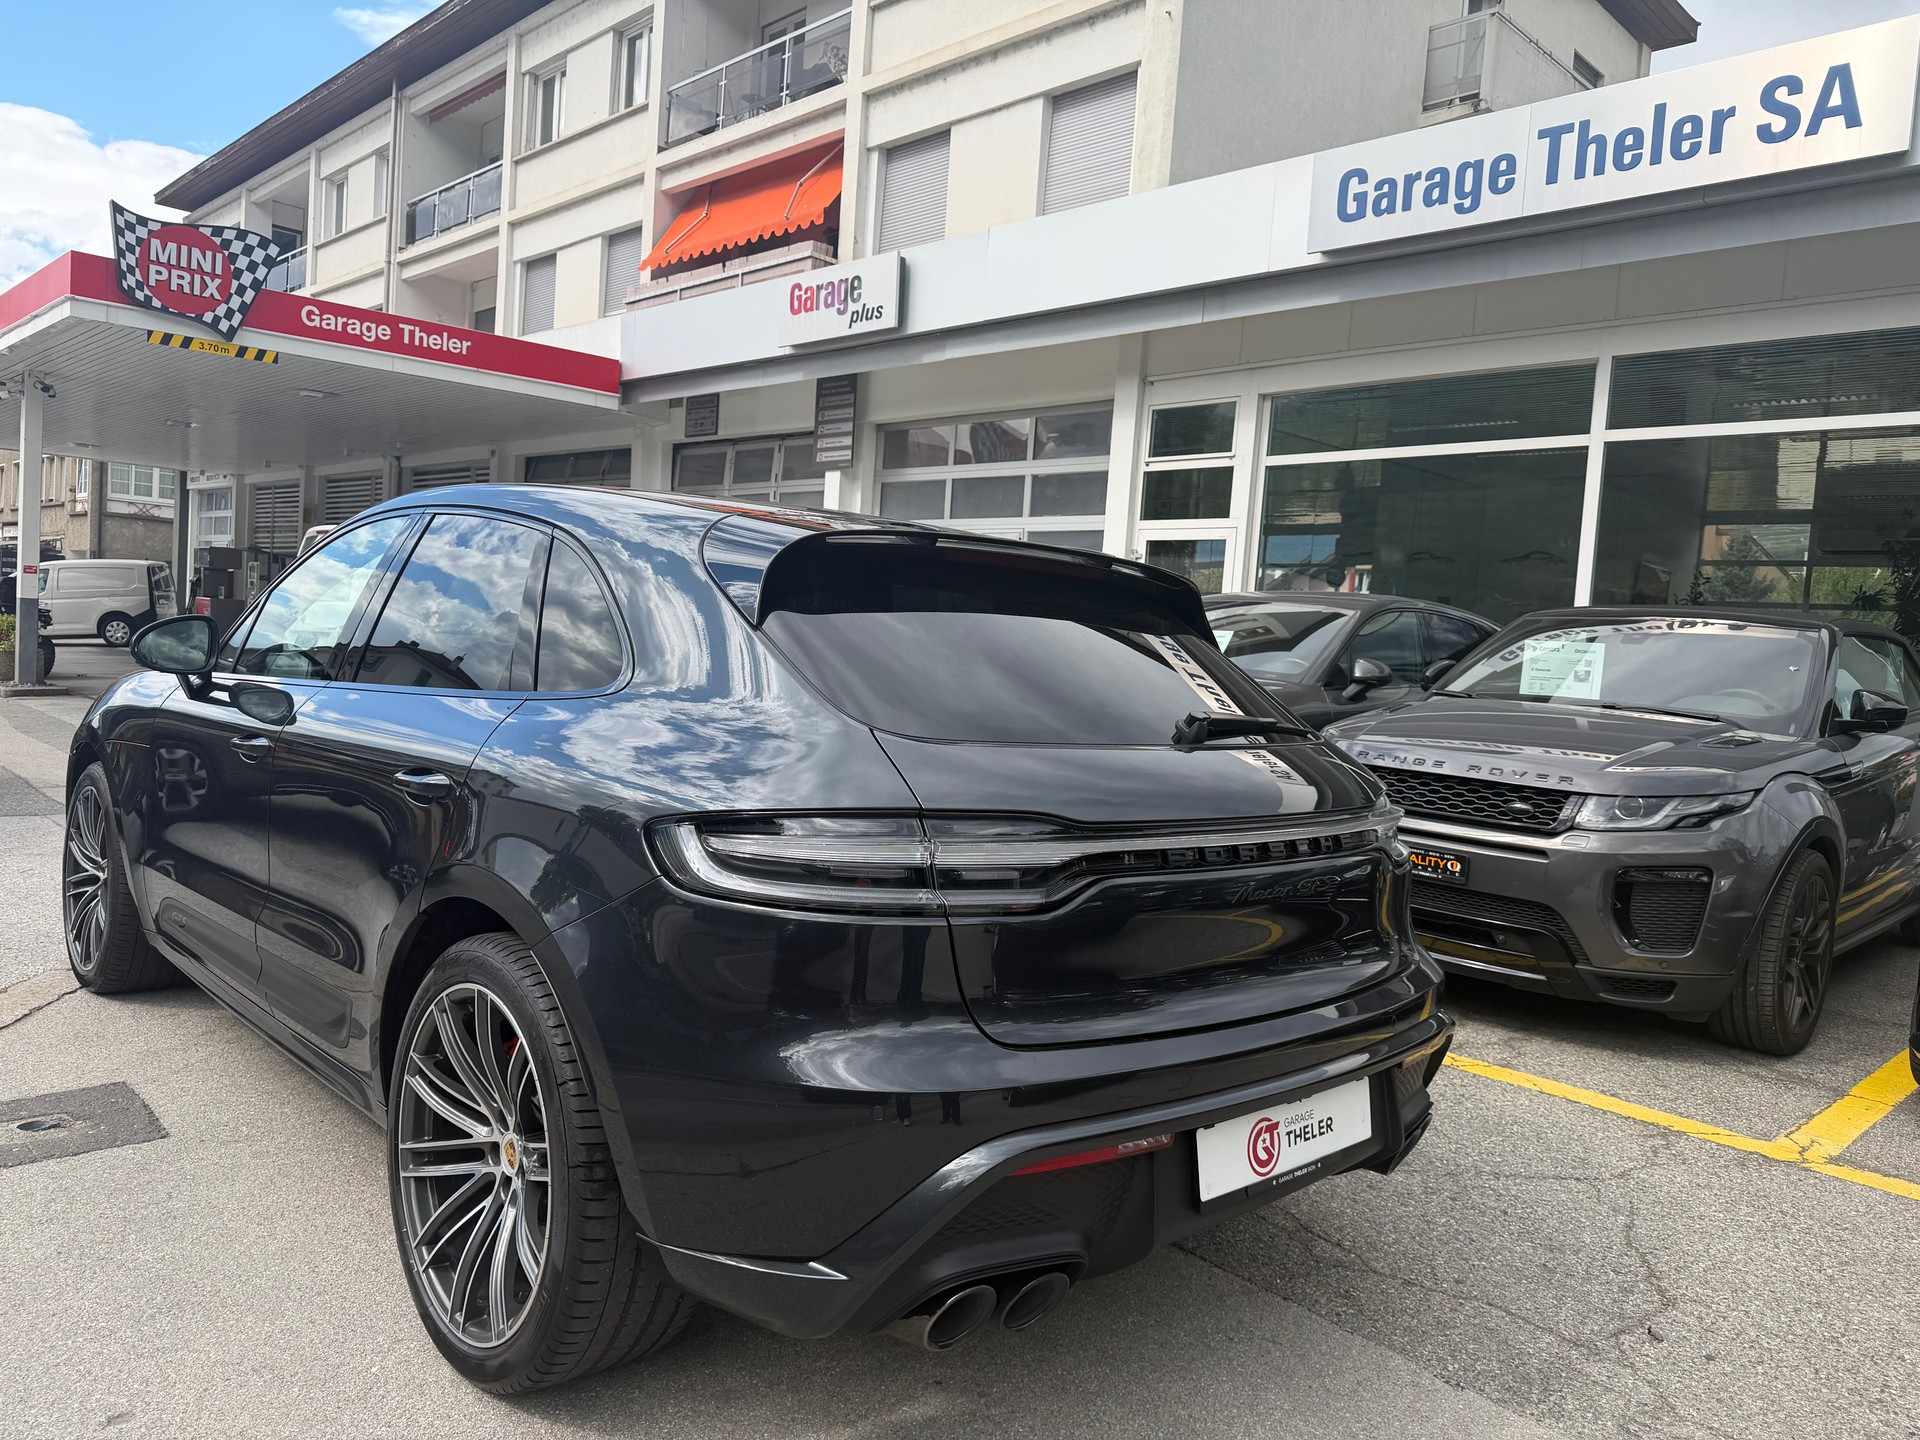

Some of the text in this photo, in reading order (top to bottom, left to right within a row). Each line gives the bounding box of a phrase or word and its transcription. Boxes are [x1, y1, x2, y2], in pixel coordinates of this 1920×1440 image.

[1336, 62, 1863, 223] Garage Theler SA
[149, 237, 223, 276] MINI
[147, 263, 223, 301] PRIX
[789, 275, 863, 316] Garage
[300, 305, 471, 355] Garage Theler
[848, 303, 884, 329] plus
[1356, 750, 1574, 786] RANGE ROVER
[1165, 834, 1355, 867] PORSCHE
[1410, 854, 1446, 867] ALITY
[1231, 875, 1342, 905] Macan GTS
[1284, 1109, 1314, 1127] GARAGE
[1285, 1116, 1333, 1147] THELER
